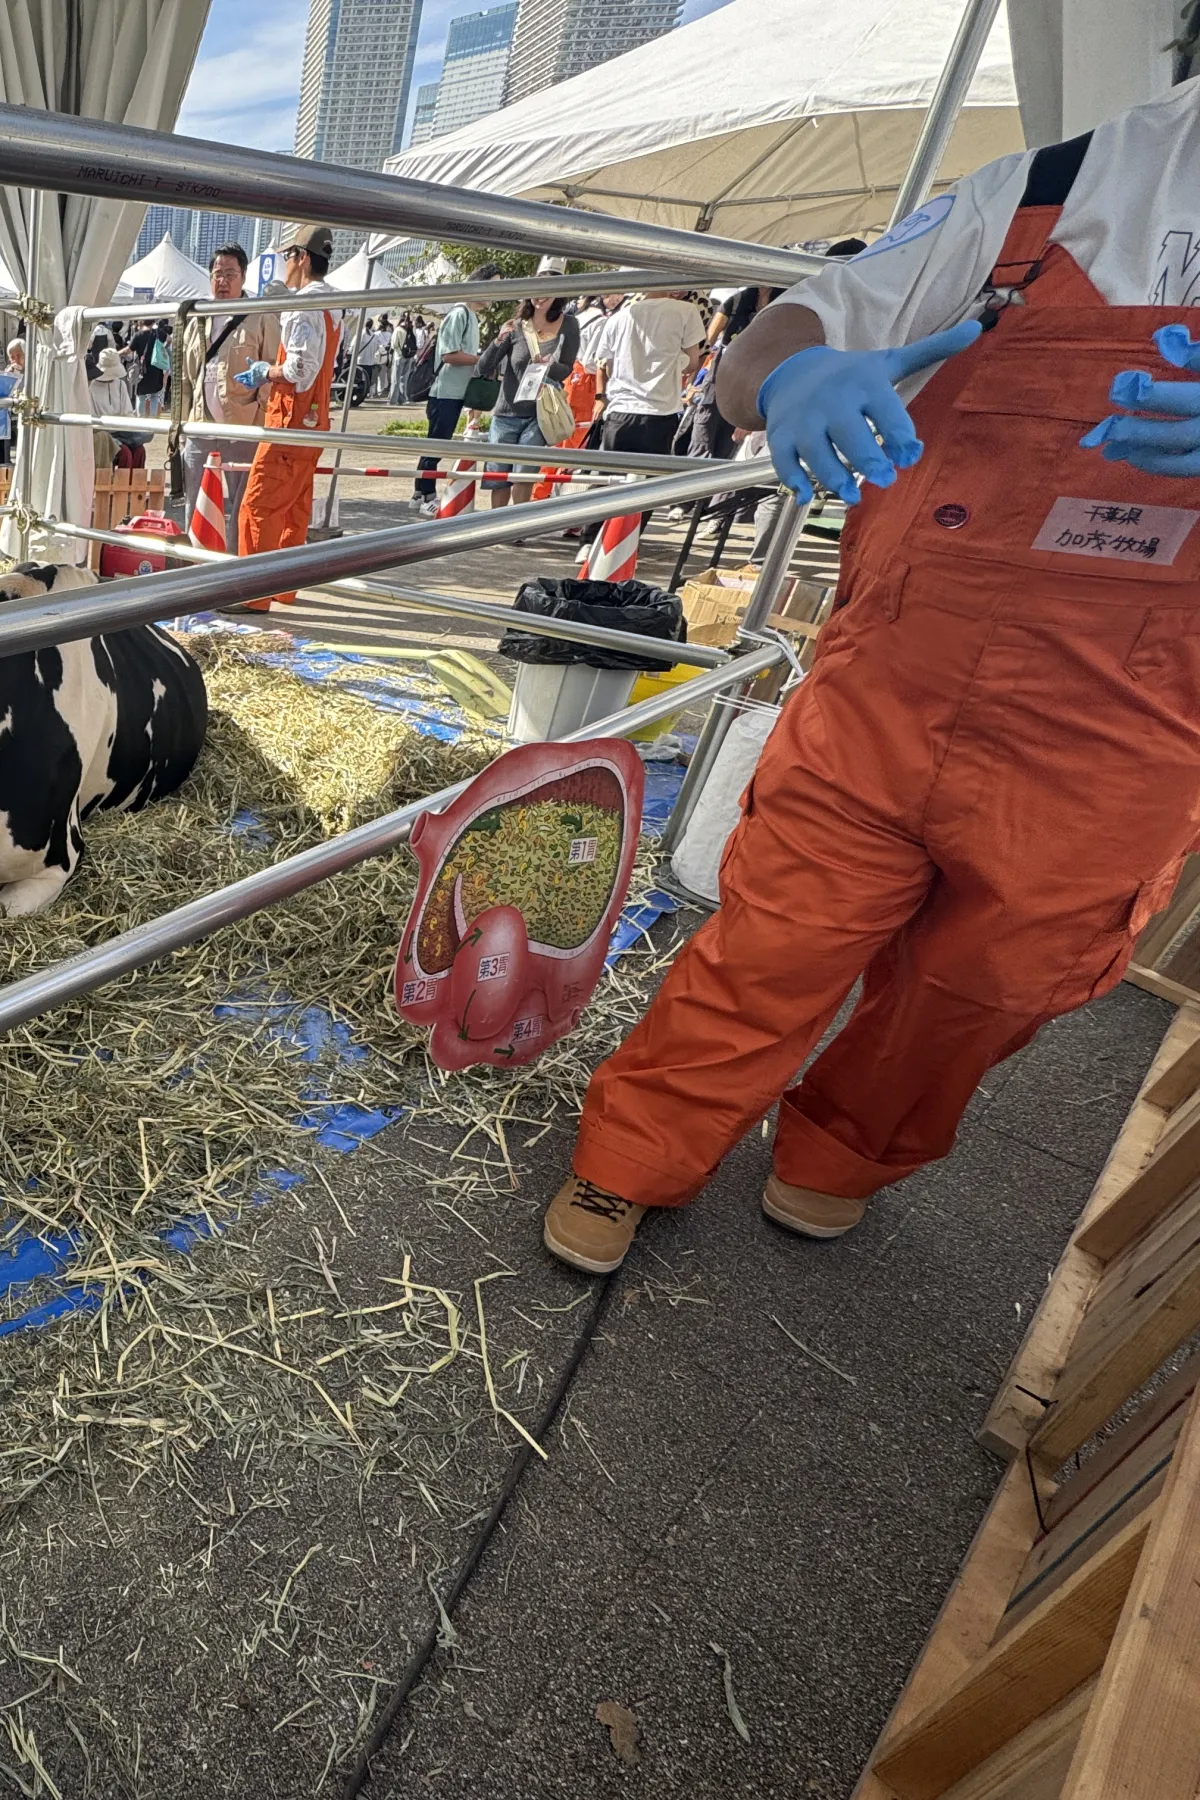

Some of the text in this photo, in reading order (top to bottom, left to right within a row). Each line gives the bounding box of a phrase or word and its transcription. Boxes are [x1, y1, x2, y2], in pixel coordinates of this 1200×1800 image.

[1084, 505, 1144, 526] 千葉県
[1055, 529, 1161, 559] 加茂牧場
[569, 839, 598, 861] 第1胃
[478, 954, 509, 980] 第3胃
[402, 979, 438, 1005] 第2胃
[511, 1015, 542, 1043] 第4胃
